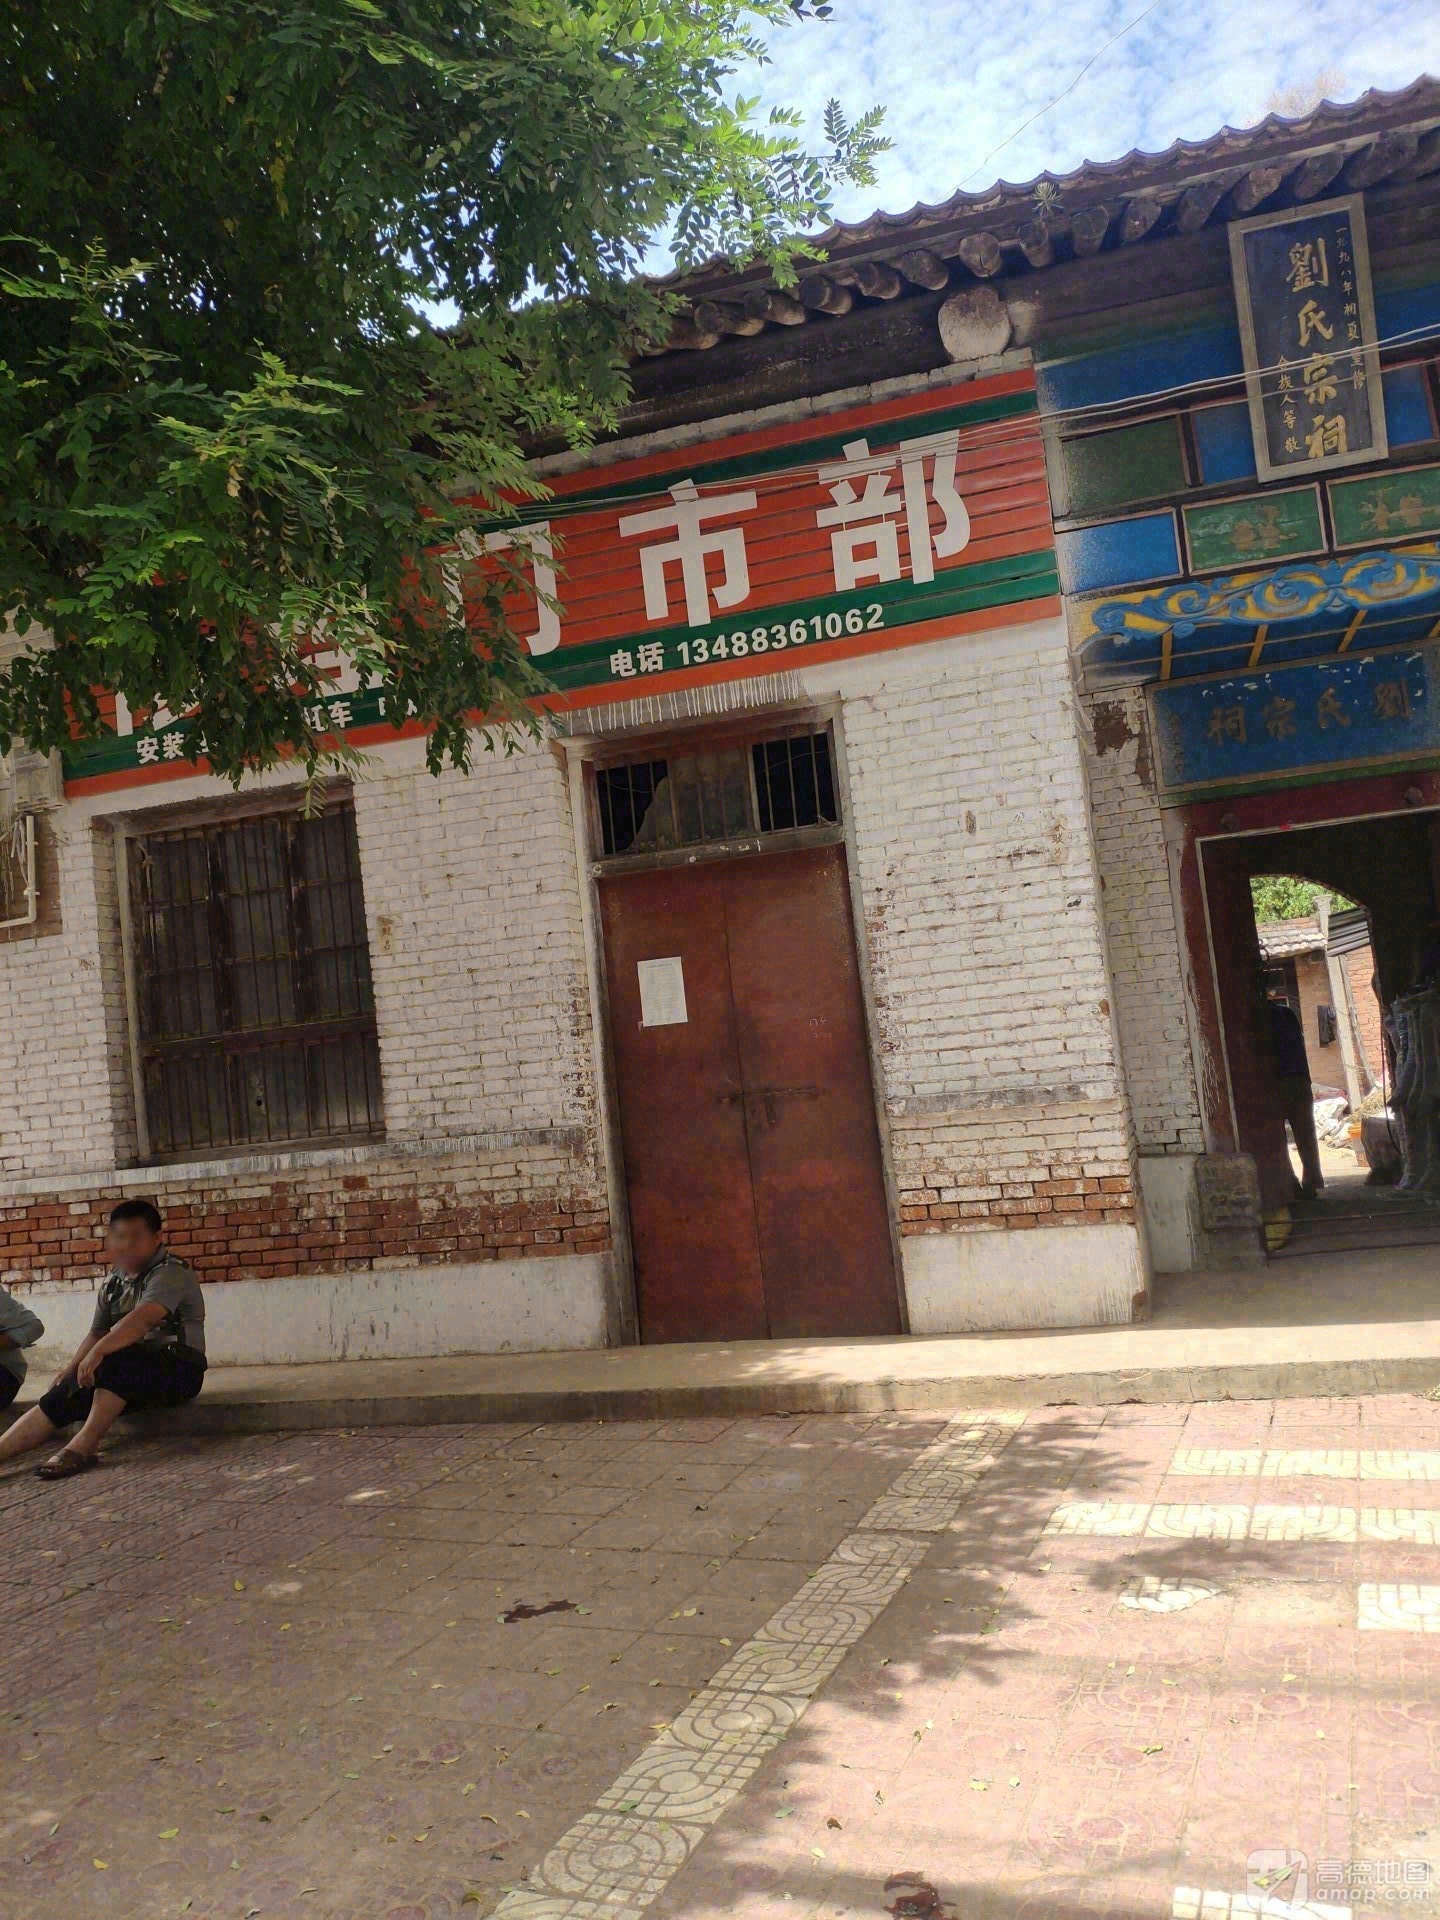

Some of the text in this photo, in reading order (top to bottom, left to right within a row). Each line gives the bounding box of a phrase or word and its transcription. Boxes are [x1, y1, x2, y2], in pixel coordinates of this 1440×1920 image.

[1286, 237, 1348, 459] 劉氏宗祠
[610, 640, 664, 678] 电话
[677, 603, 885, 665] 13488361062
